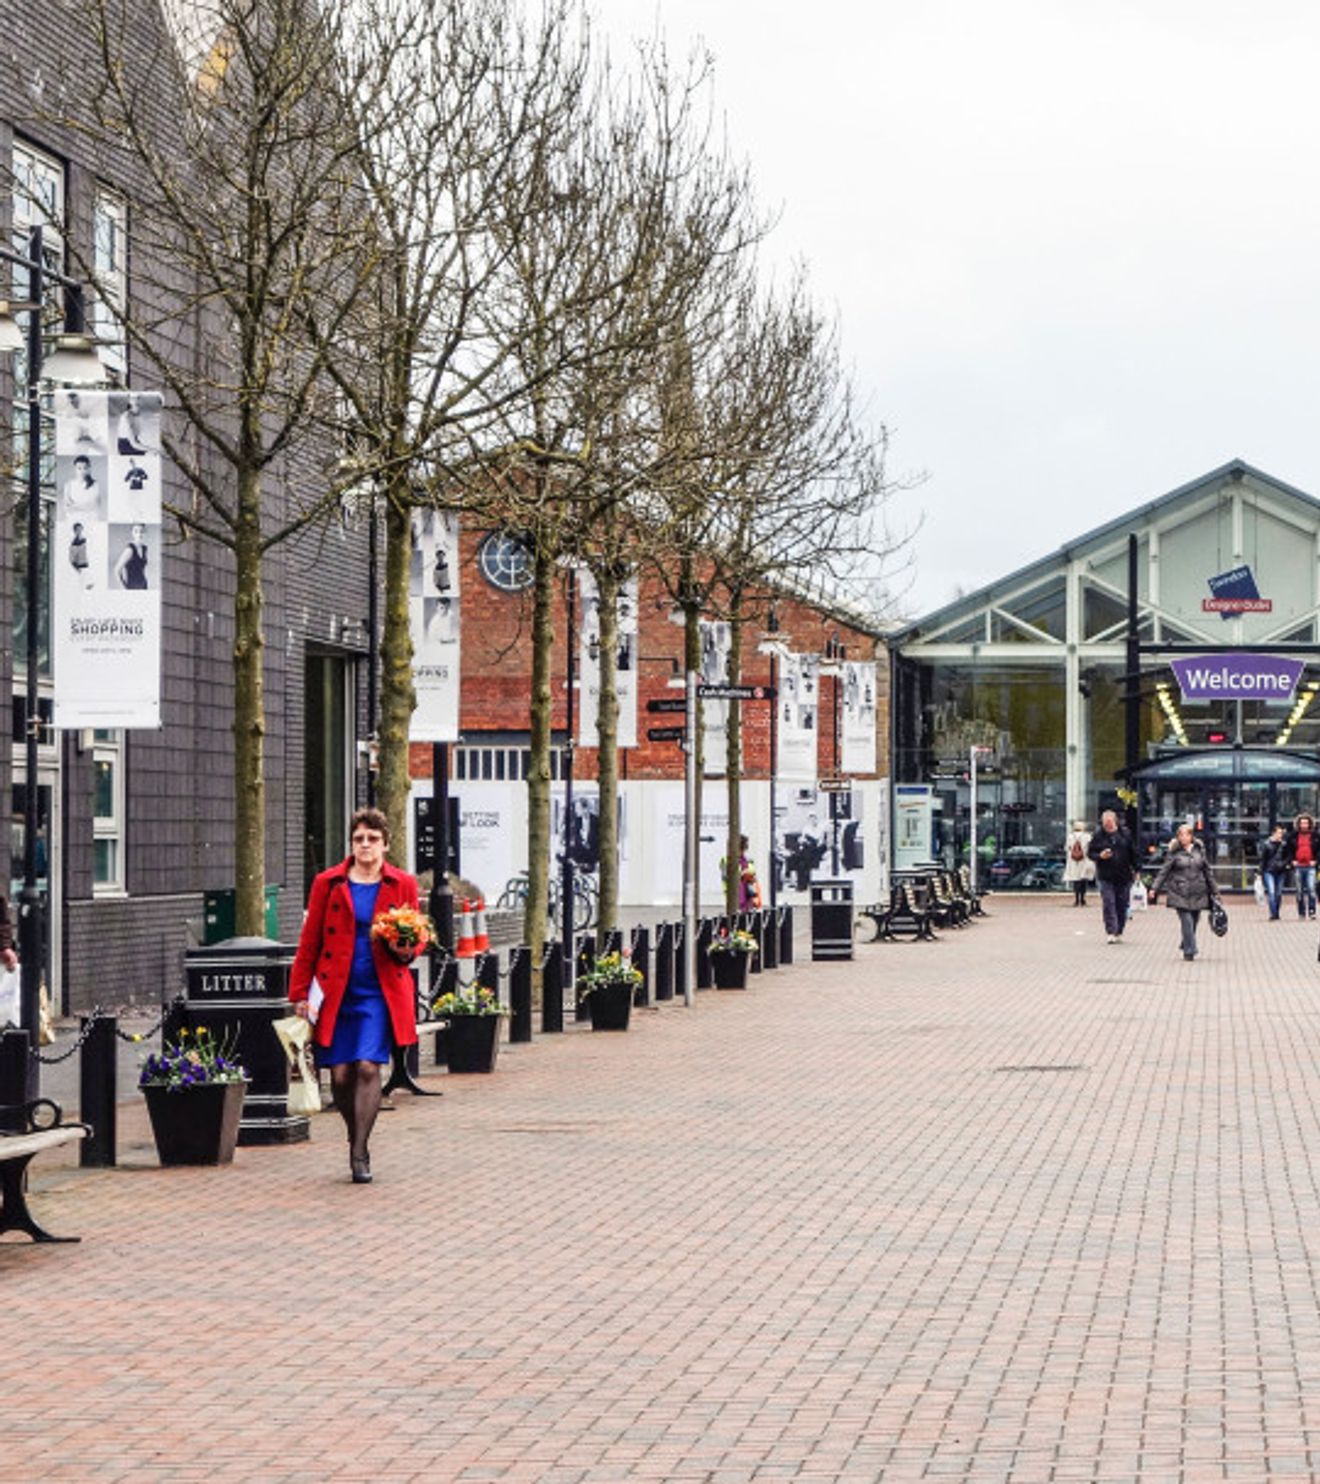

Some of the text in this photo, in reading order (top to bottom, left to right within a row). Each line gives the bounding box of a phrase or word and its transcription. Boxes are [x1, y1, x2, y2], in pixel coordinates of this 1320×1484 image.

[71, 624, 143, 634] SHOPPING
[1186, 667, 1292, 690] Welcome
[202, 975, 267, 992] LITTER
